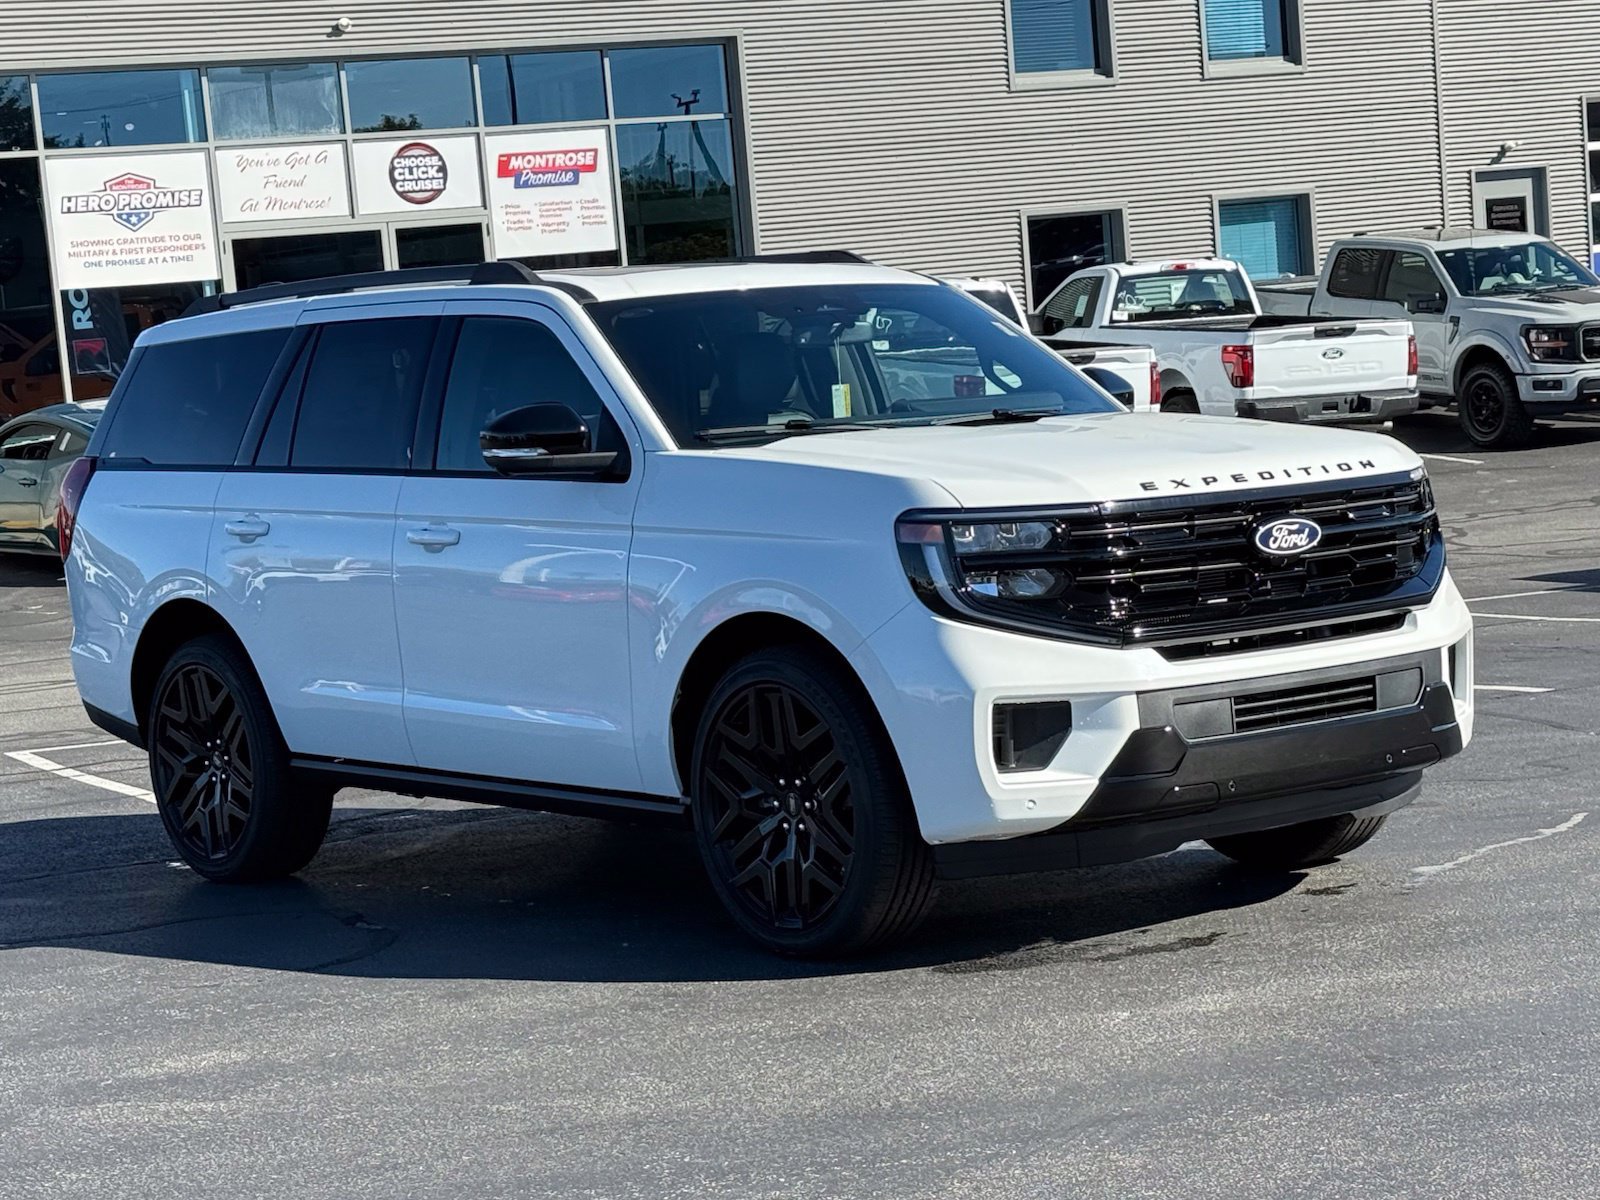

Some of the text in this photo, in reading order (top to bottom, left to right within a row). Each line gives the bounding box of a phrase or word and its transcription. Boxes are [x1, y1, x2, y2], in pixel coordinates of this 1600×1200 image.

[236, 150, 328, 173] You've Got A
[393, 156, 443, 168] CHOOSE.
[508, 152, 595, 170] MONTROSE
[394, 166, 444, 180] CLICK.
[520, 170, 575, 186] Promise
[263, 174, 308, 189] Friend
[395, 179, 445, 192] CRUISE!
[61, 189, 202, 214] HERO PROMISE
[240, 196, 332, 213] At Montrose!
[70, 239, 115, 248] SHOWING
[116, 235, 167, 246] GRATITUDE
[182, 233, 202, 241] OUR
[68, 248, 110, 258] MILITARY
[120, 247, 145, 256] FIRST
[146, 243, 207, 253] RESPONDERS
[83, 260, 104, 268] ONE
[105, 257, 147, 267] PROMISE
[170, 254, 194, 262] TIME!
[1139, 459, 1376, 492] EXPEDITION
[1269, 523, 1309, 549] Ford
